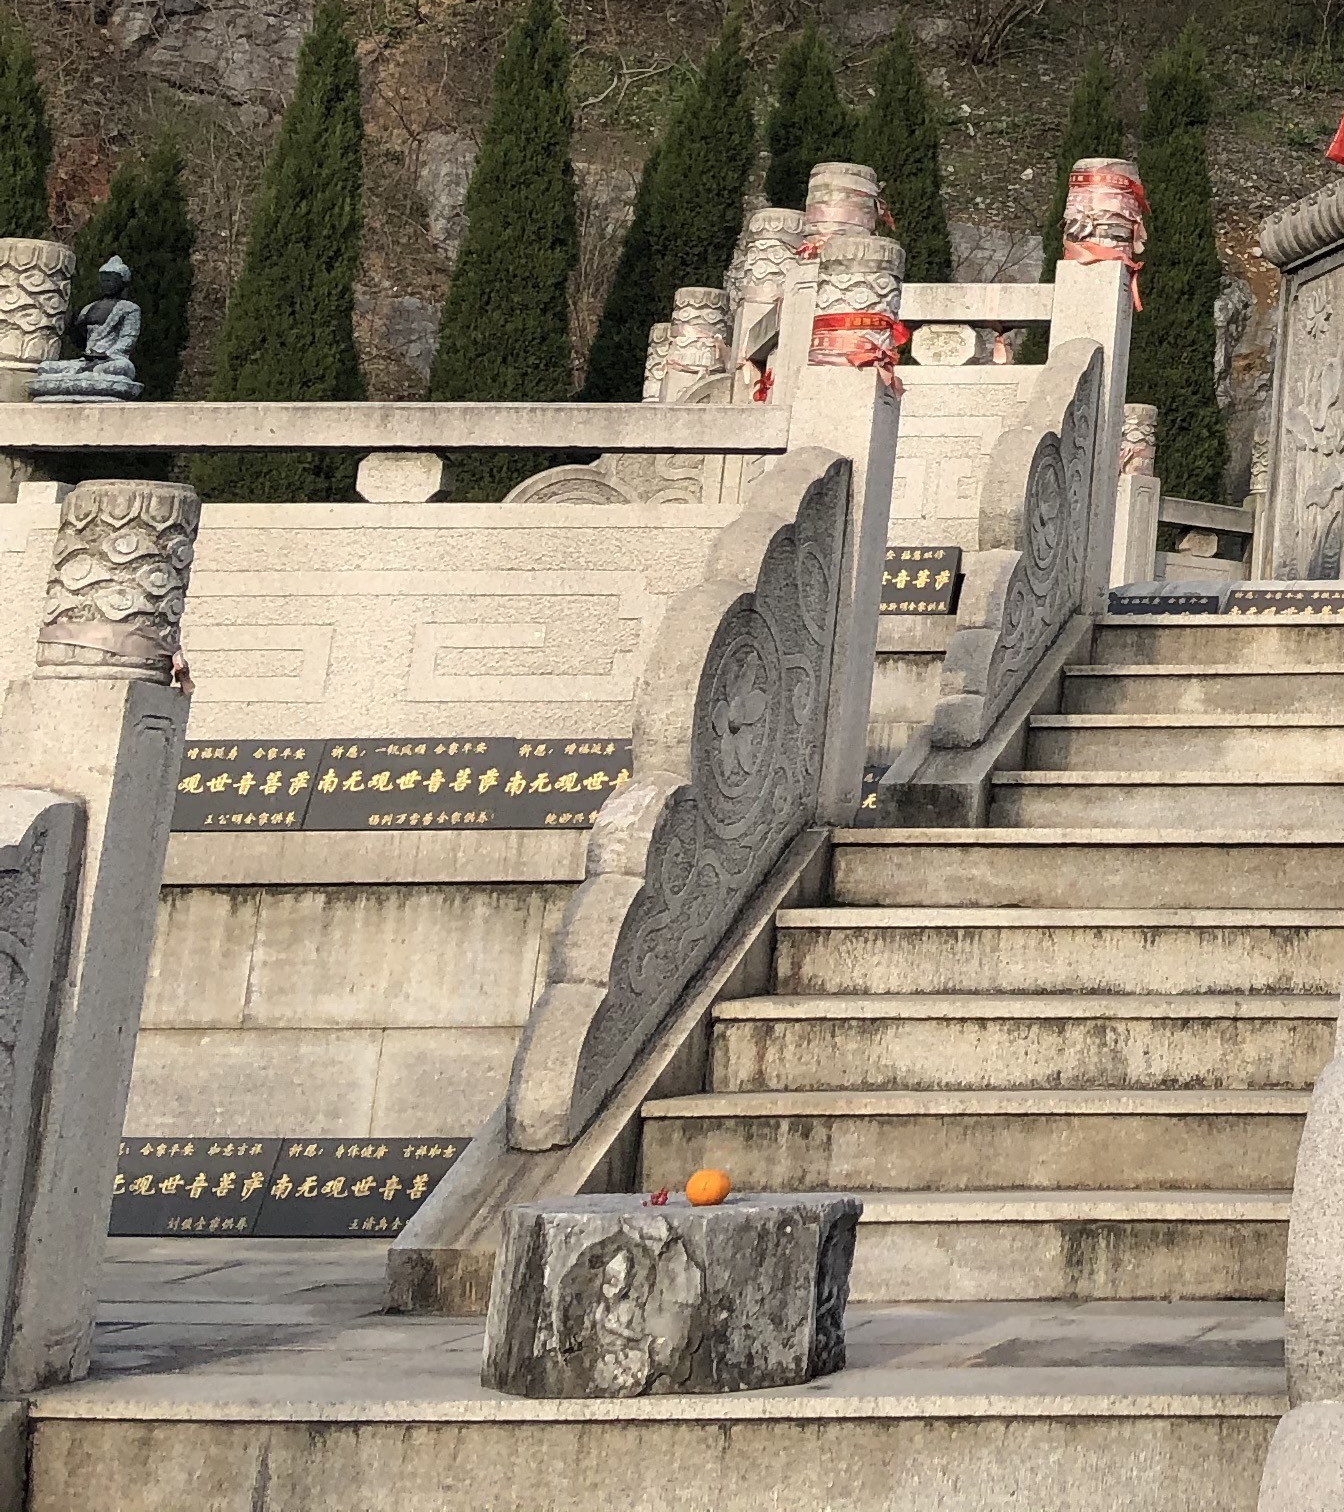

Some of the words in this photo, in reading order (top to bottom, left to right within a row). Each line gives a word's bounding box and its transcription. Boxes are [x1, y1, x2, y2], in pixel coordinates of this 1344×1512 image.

[178, 770, 310, 796] 观世音菩萨
[318, 767, 500, 795] 南无观世音菩萨
[270, 1173, 430, 1200] 南无观世音菩
